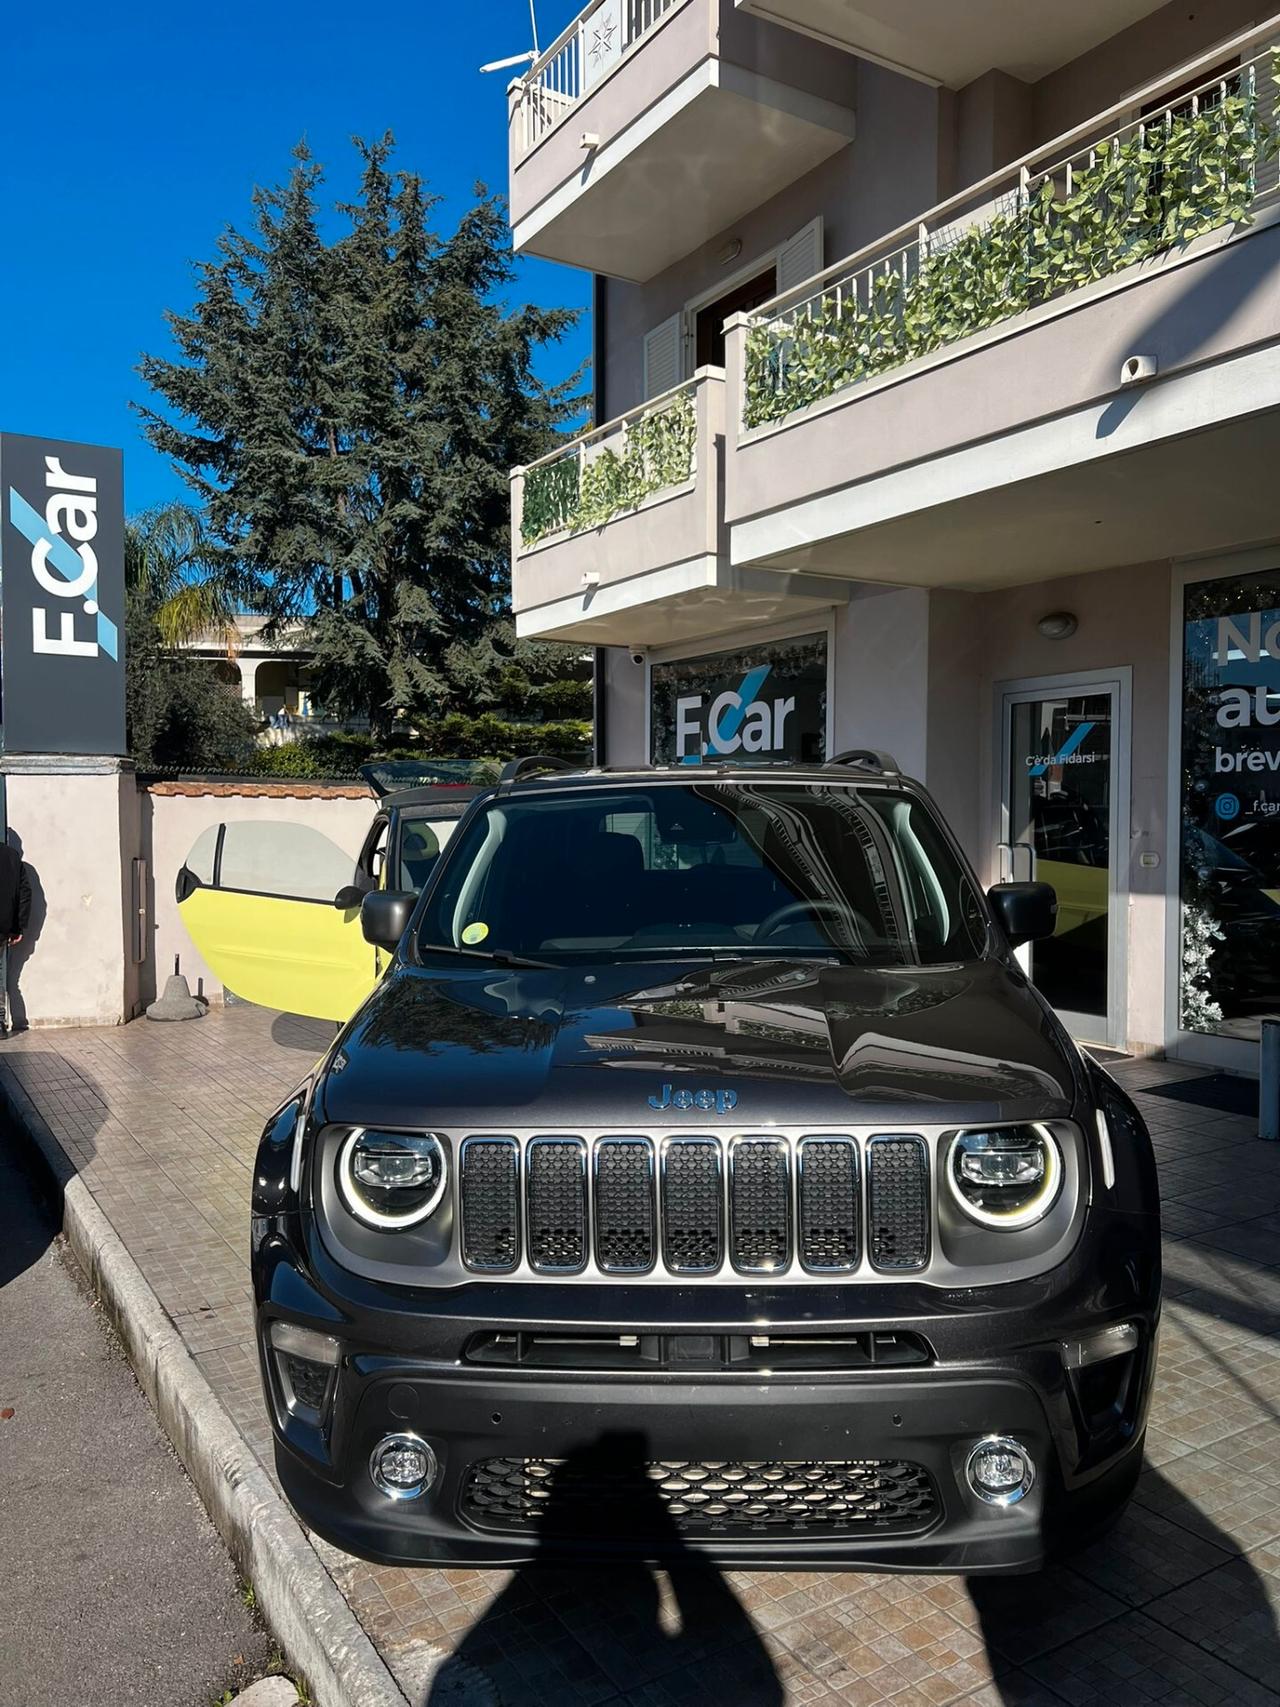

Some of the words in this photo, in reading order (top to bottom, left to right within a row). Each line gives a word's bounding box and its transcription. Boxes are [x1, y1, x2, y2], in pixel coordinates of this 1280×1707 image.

[32, 455, 99, 657] F.Car
[676, 690, 795, 757] F.Car
[648, 1084, 737, 1116] Jeep
